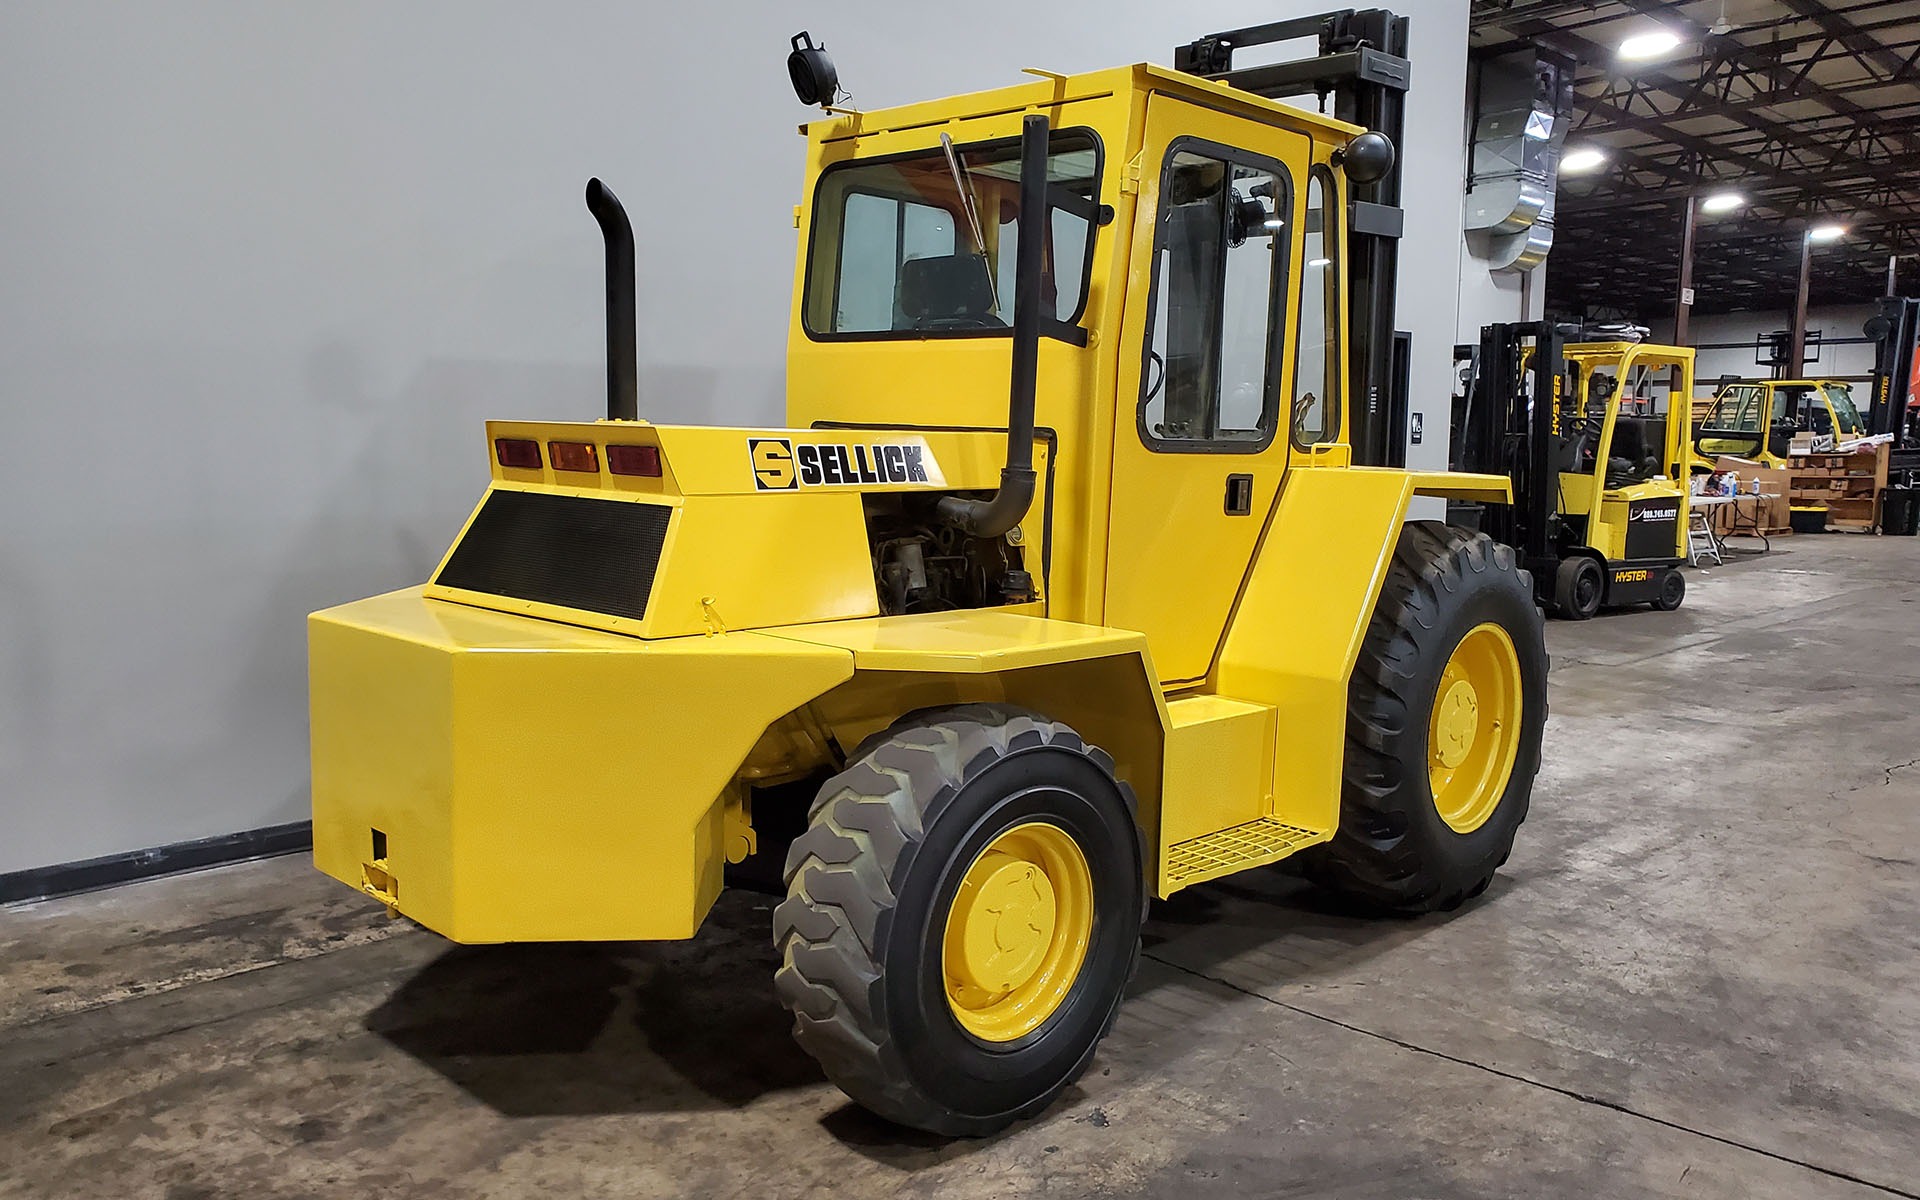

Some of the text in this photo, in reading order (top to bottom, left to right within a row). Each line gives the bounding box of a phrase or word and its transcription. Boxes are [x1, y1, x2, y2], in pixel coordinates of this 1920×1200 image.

[1552, 374, 1561, 436] HYSTER
[797, 445, 928, 485] SELLICK
[1615, 570, 1647, 583] HYSTER
